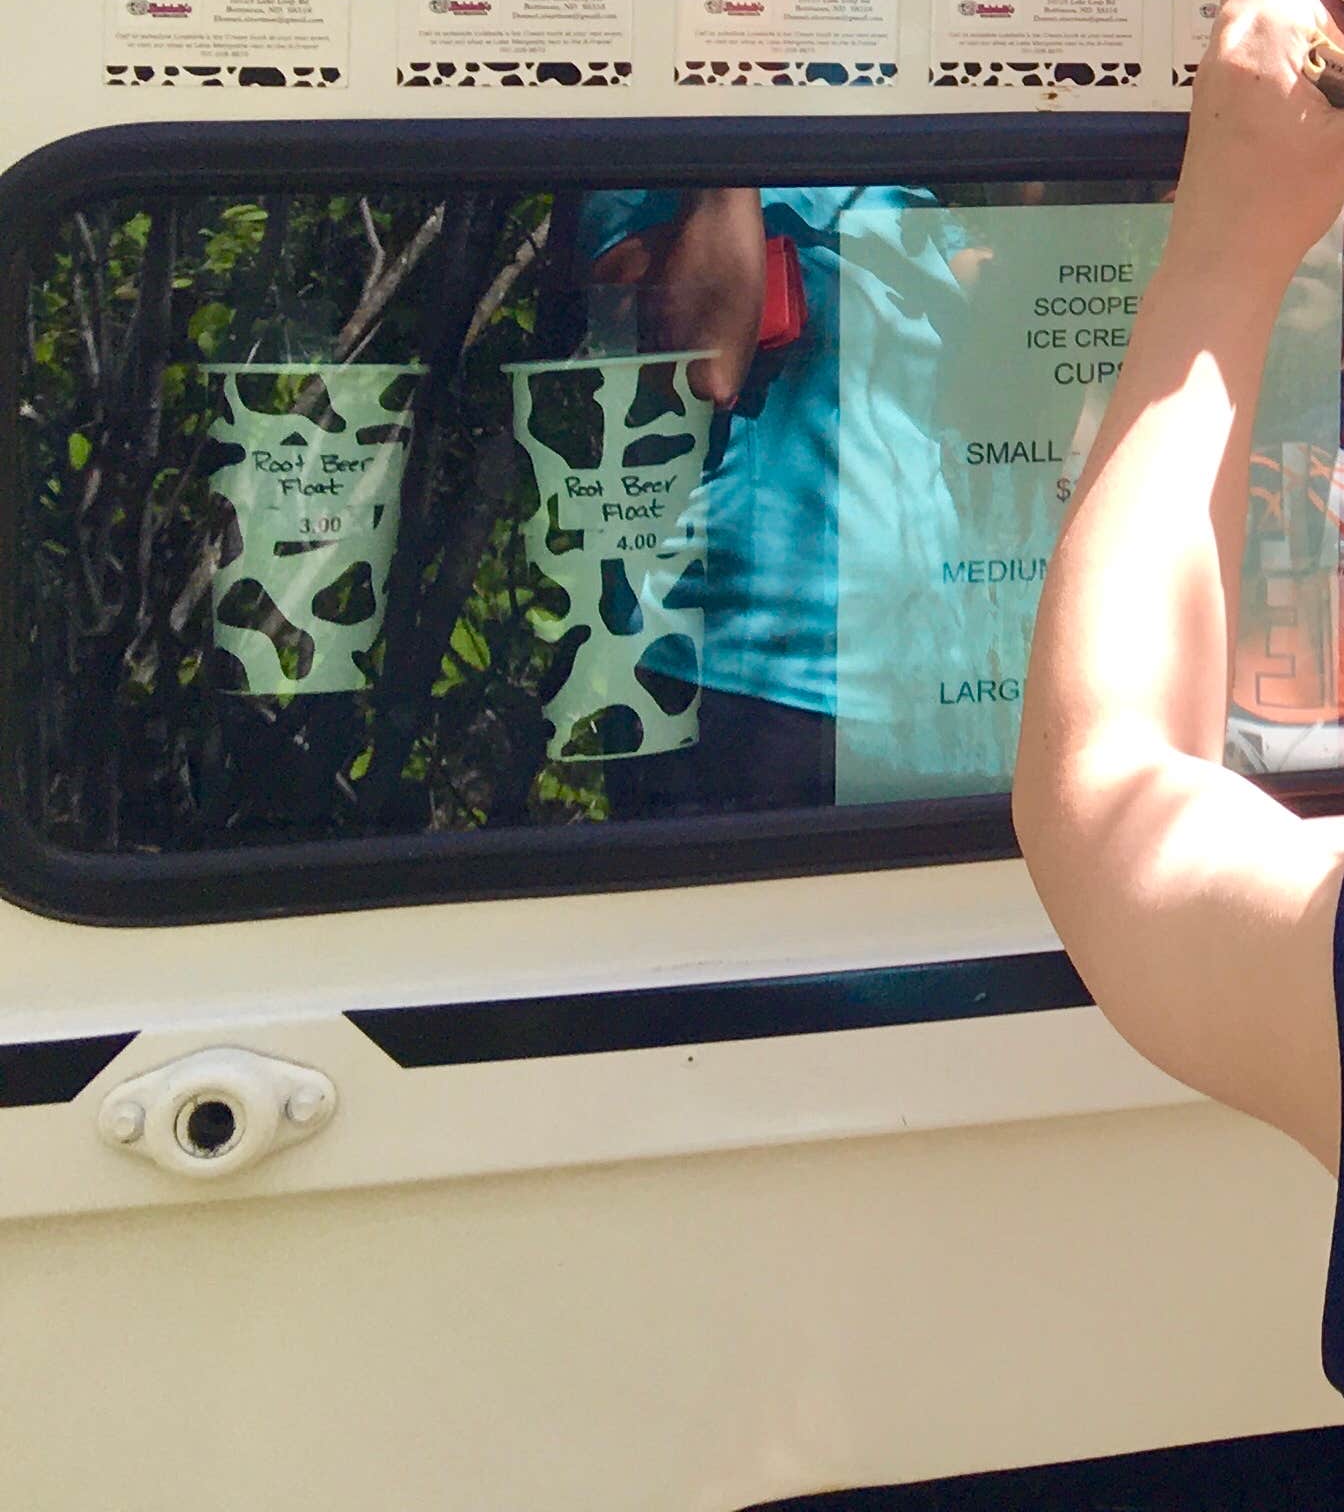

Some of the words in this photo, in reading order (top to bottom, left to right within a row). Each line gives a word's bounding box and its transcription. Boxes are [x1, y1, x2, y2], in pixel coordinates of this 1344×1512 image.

[1058, 263, 1135, 284] PRIDE
[1033, 295, 1143, 317] SCOOPE
[1026, 328, 1070, 349] ICE
[254, 450, 305, 474] Root
[320, 454, 375, 474] Beer
[966, 440, 1064, 466] SMALL
[280, 478, 345, 497] Float
[565, 474, 605, 498] Root
[620, 474, 678, 497] Beer
[602, 499, 666, 522] Float
[299, 515, 342, 534] 3.00
[616, 533, 658, 551] 4.00
[939, 680, 1024, 706] LARG
